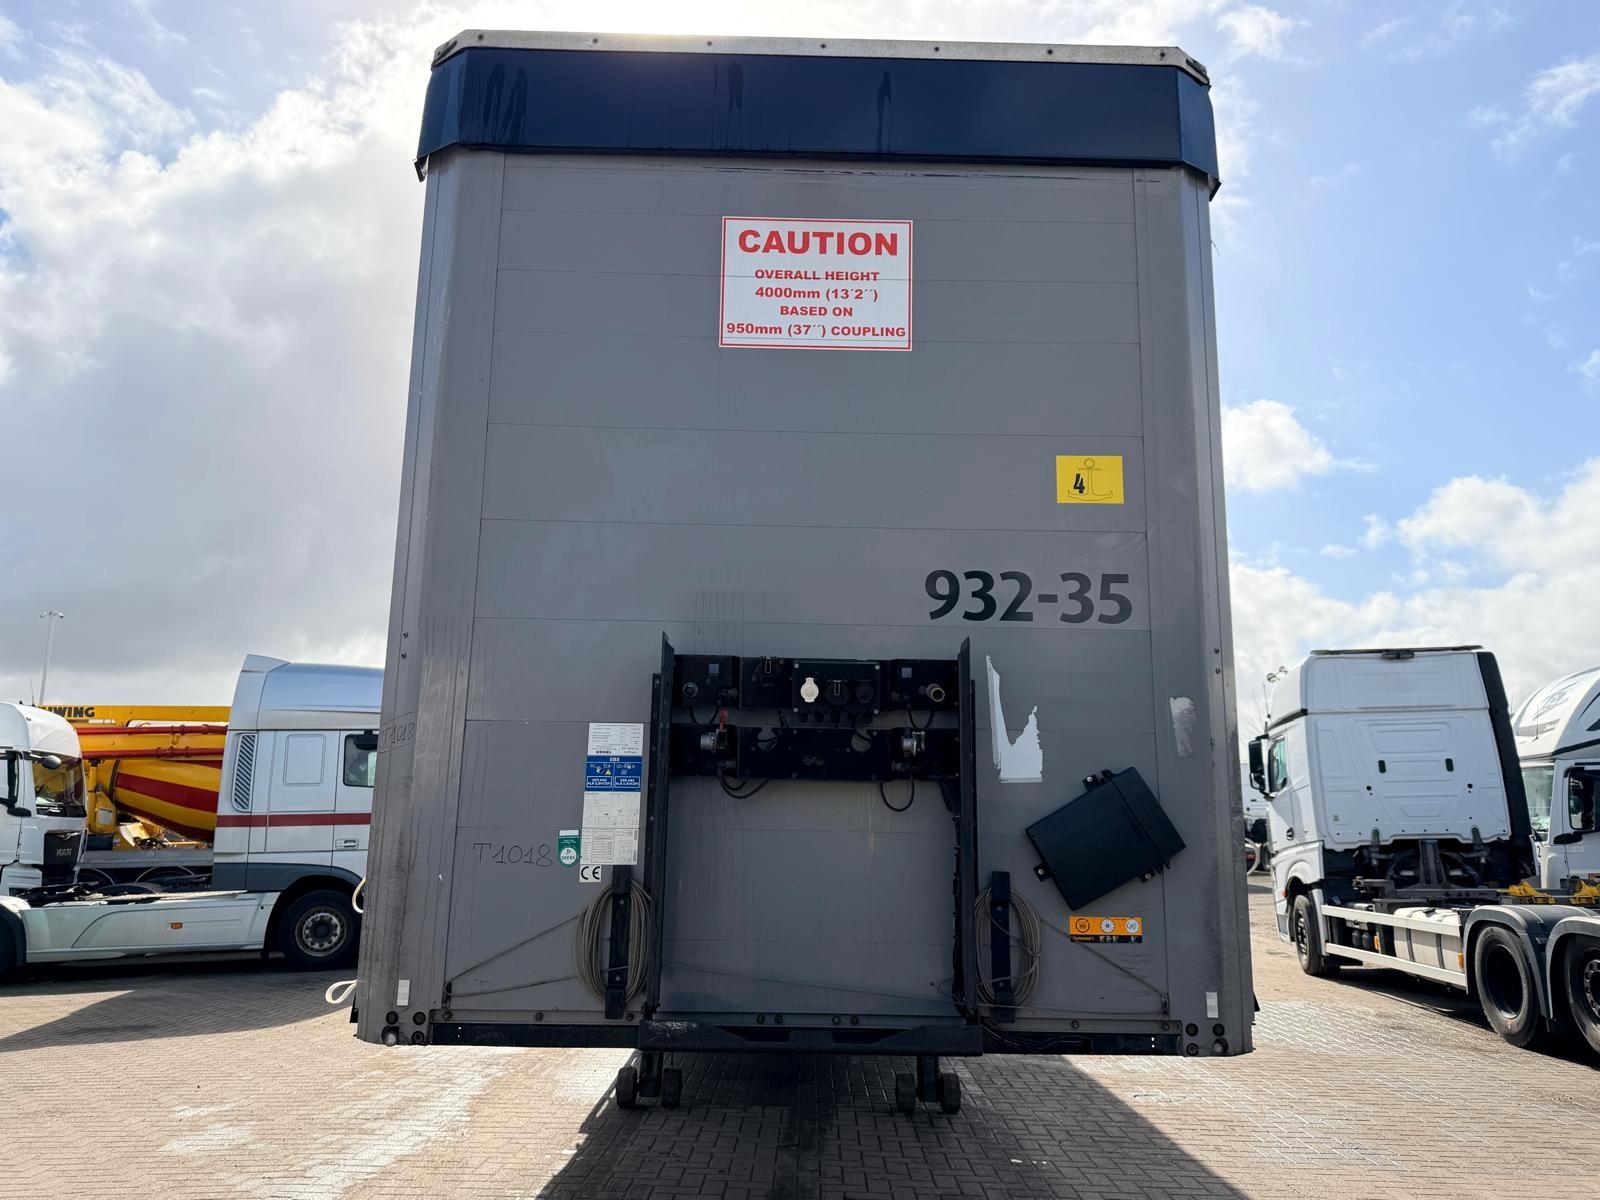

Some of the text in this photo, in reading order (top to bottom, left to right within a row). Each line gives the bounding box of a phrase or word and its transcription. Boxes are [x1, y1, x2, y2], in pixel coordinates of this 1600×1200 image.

[738, 229, 898, 256] CAUTION
[754, 269, 880, 282] OVERALL HEIGHT
[755, 286, 820, 299] 4000mm
[780, 305, 853, 317] BASED ON
[726, 322, 782, 335] 950mm
[831, 326, 906, 338] COUPLING
[1073, 473, 1086, 494] 4
[924, 569, 1133, 625] 932-35
[473, 842, 553, 868] T1018
